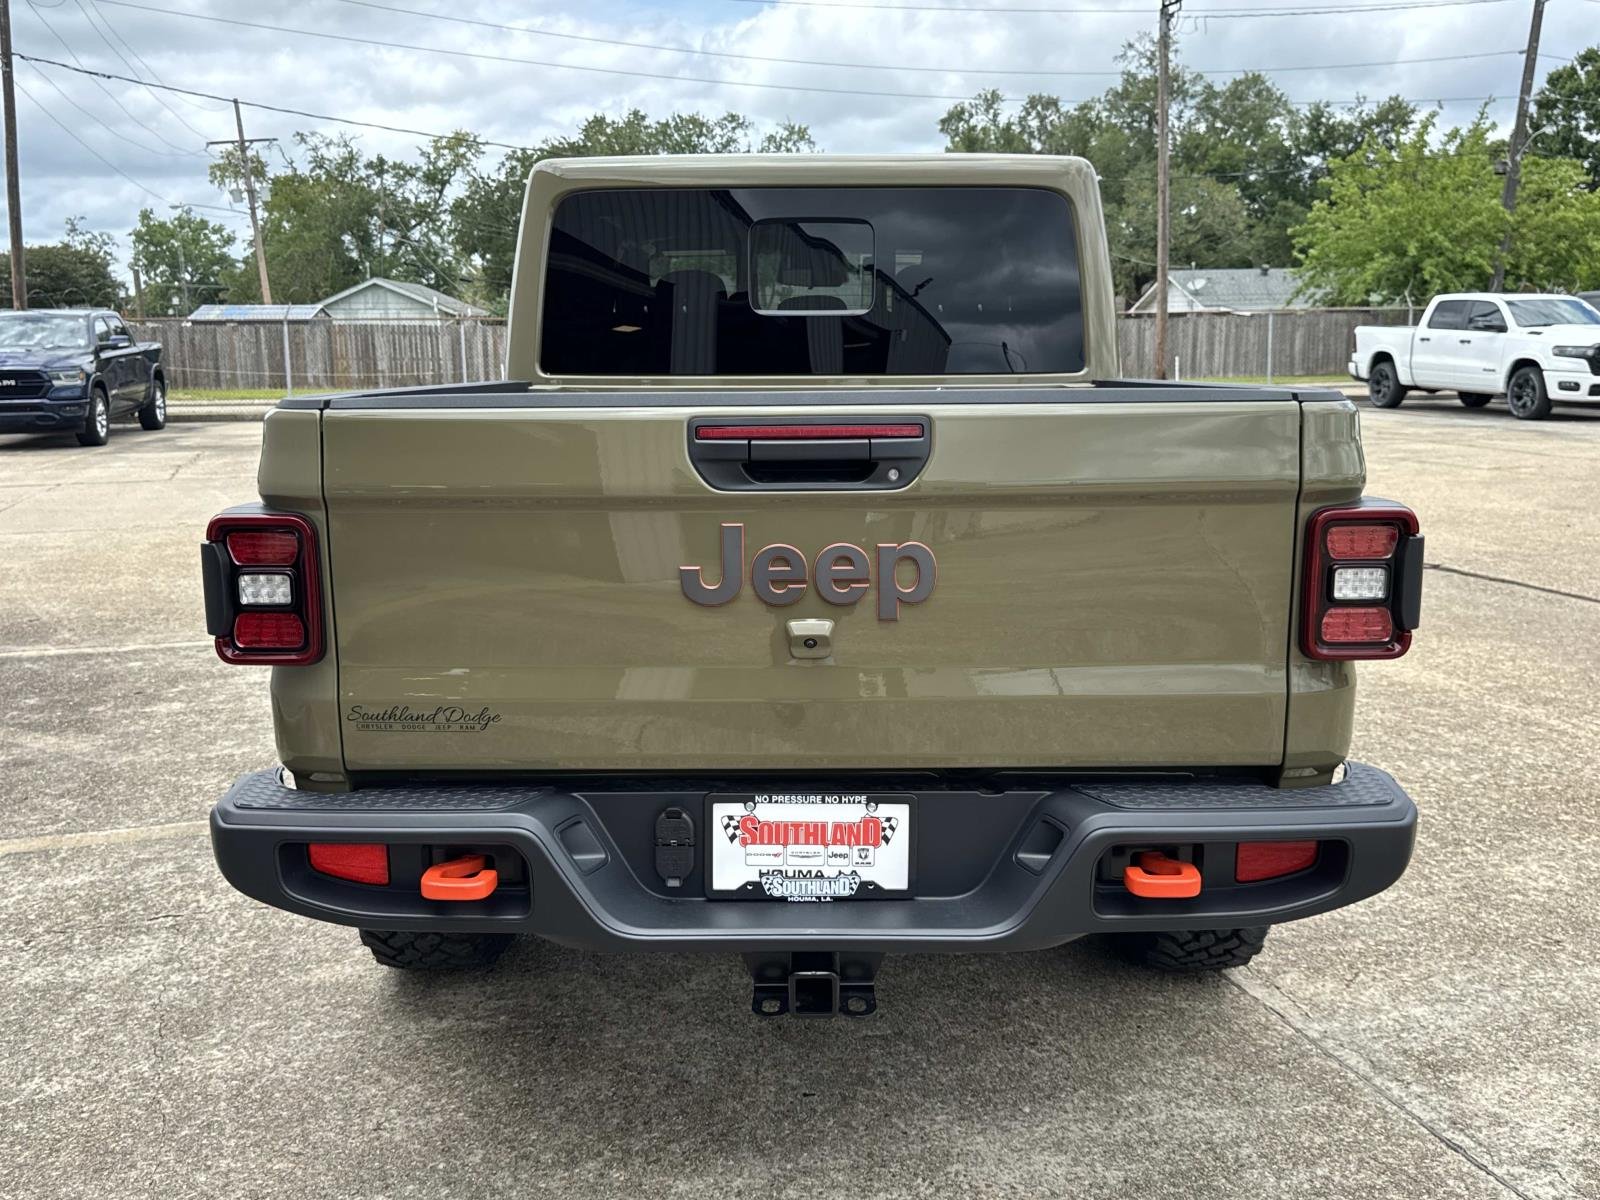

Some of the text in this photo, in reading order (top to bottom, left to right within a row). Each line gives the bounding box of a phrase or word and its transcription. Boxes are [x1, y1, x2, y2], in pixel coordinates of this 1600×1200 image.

[679, 522, 938, 621] Jeep
[347, 705, 502, 731] Southland Dodge
[755, 795, 867, 804] NO PRESSURE NO HYPE
[739, 815, 882, 848] SOUTHLAND
[828, 851, 849, 860] Jeep
[772, 876, 851, 896] SOUTHLAND
